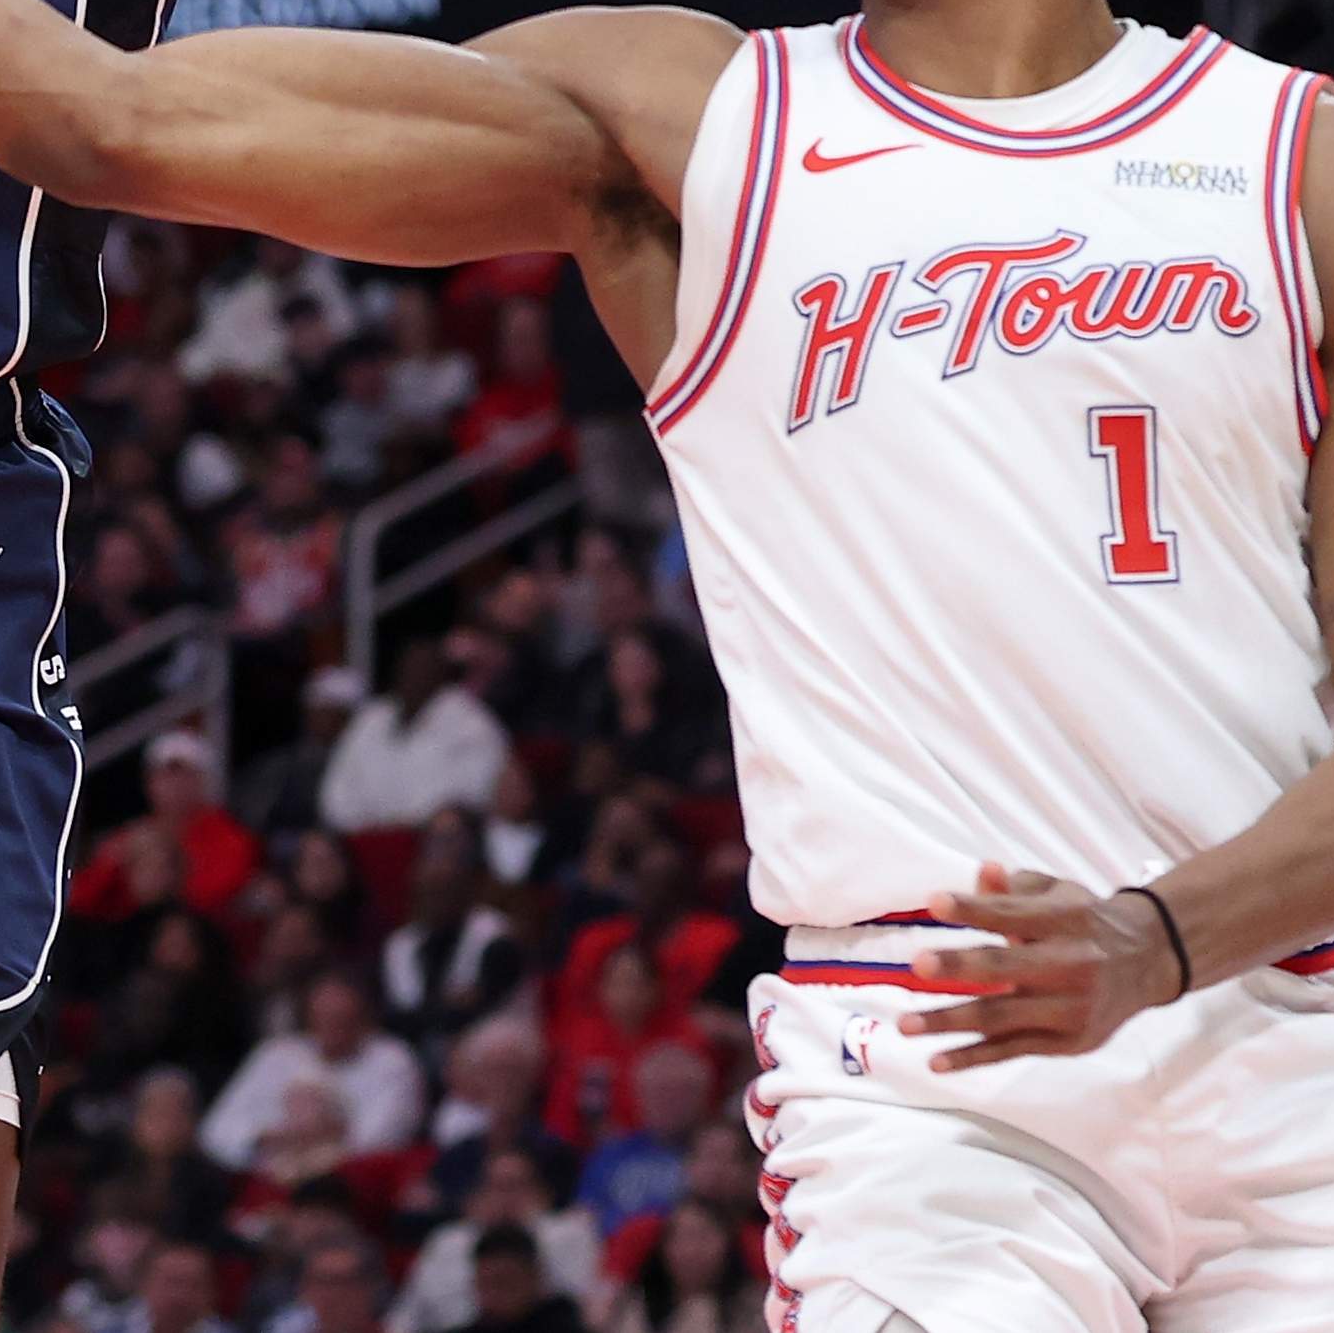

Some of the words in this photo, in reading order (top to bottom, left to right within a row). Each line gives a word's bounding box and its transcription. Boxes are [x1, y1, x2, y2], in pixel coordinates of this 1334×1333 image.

[1115, 159, 1249, 184] MEMORIAL
[788, 229, 1261, 435] H-Town
[1088, 405, 1179, 584] 1
